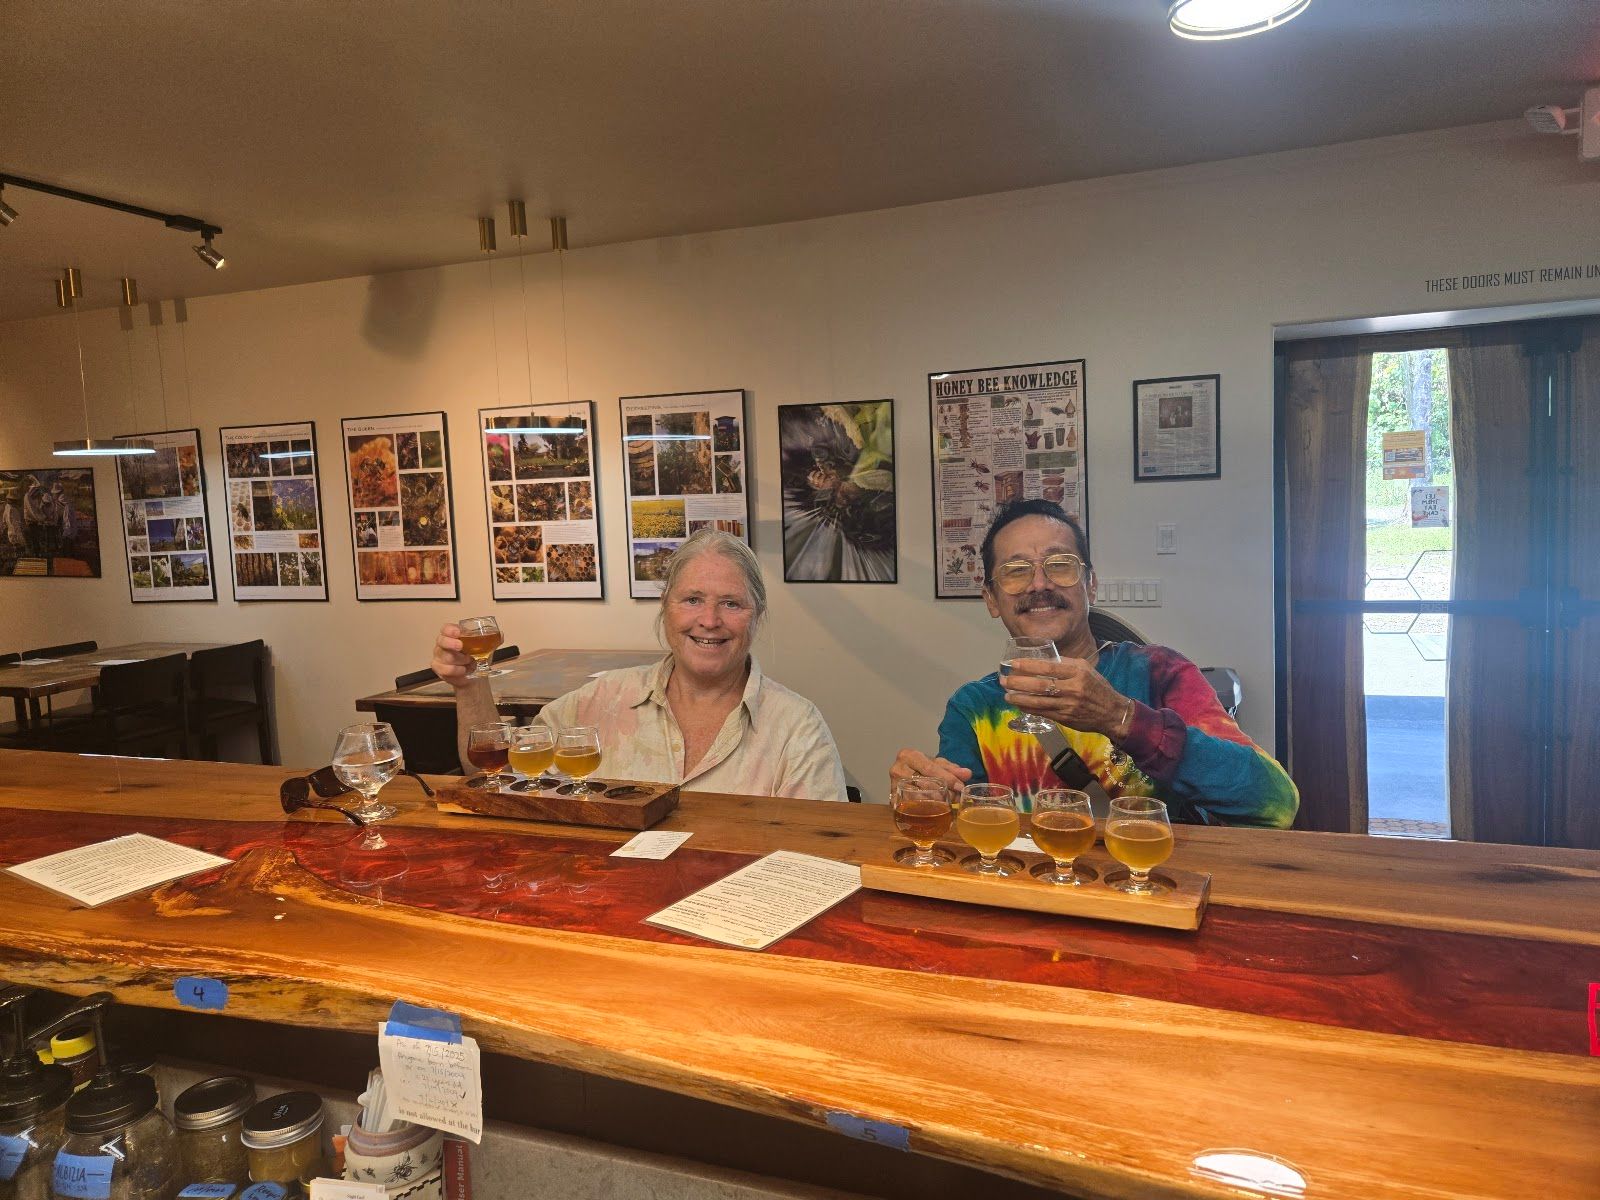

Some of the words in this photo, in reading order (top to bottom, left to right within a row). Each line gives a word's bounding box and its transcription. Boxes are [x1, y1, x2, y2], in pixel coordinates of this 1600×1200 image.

[1425, 277, 1458, 293] THESE
[1462, 273, 1500, 290] DOORS
[1504, 269, 1535, 286] MUST
[1540, 265, 1582, 283] REMAIN
[935, 379, 974, 397] HONEY
[977, 376, 1000, 393] BEE
[1003, 369, 1078, 391] KNOWLEDGE
[192, 985, 205, 1002] 4
[419, 1112, 447, 1126] allowed
[456, 1119, 468, 1130] the
[862, 1127, 877, 1141] 5
[455, 1145, 465, 1181] Manual
[457, 1182, 466, 1200] ser
